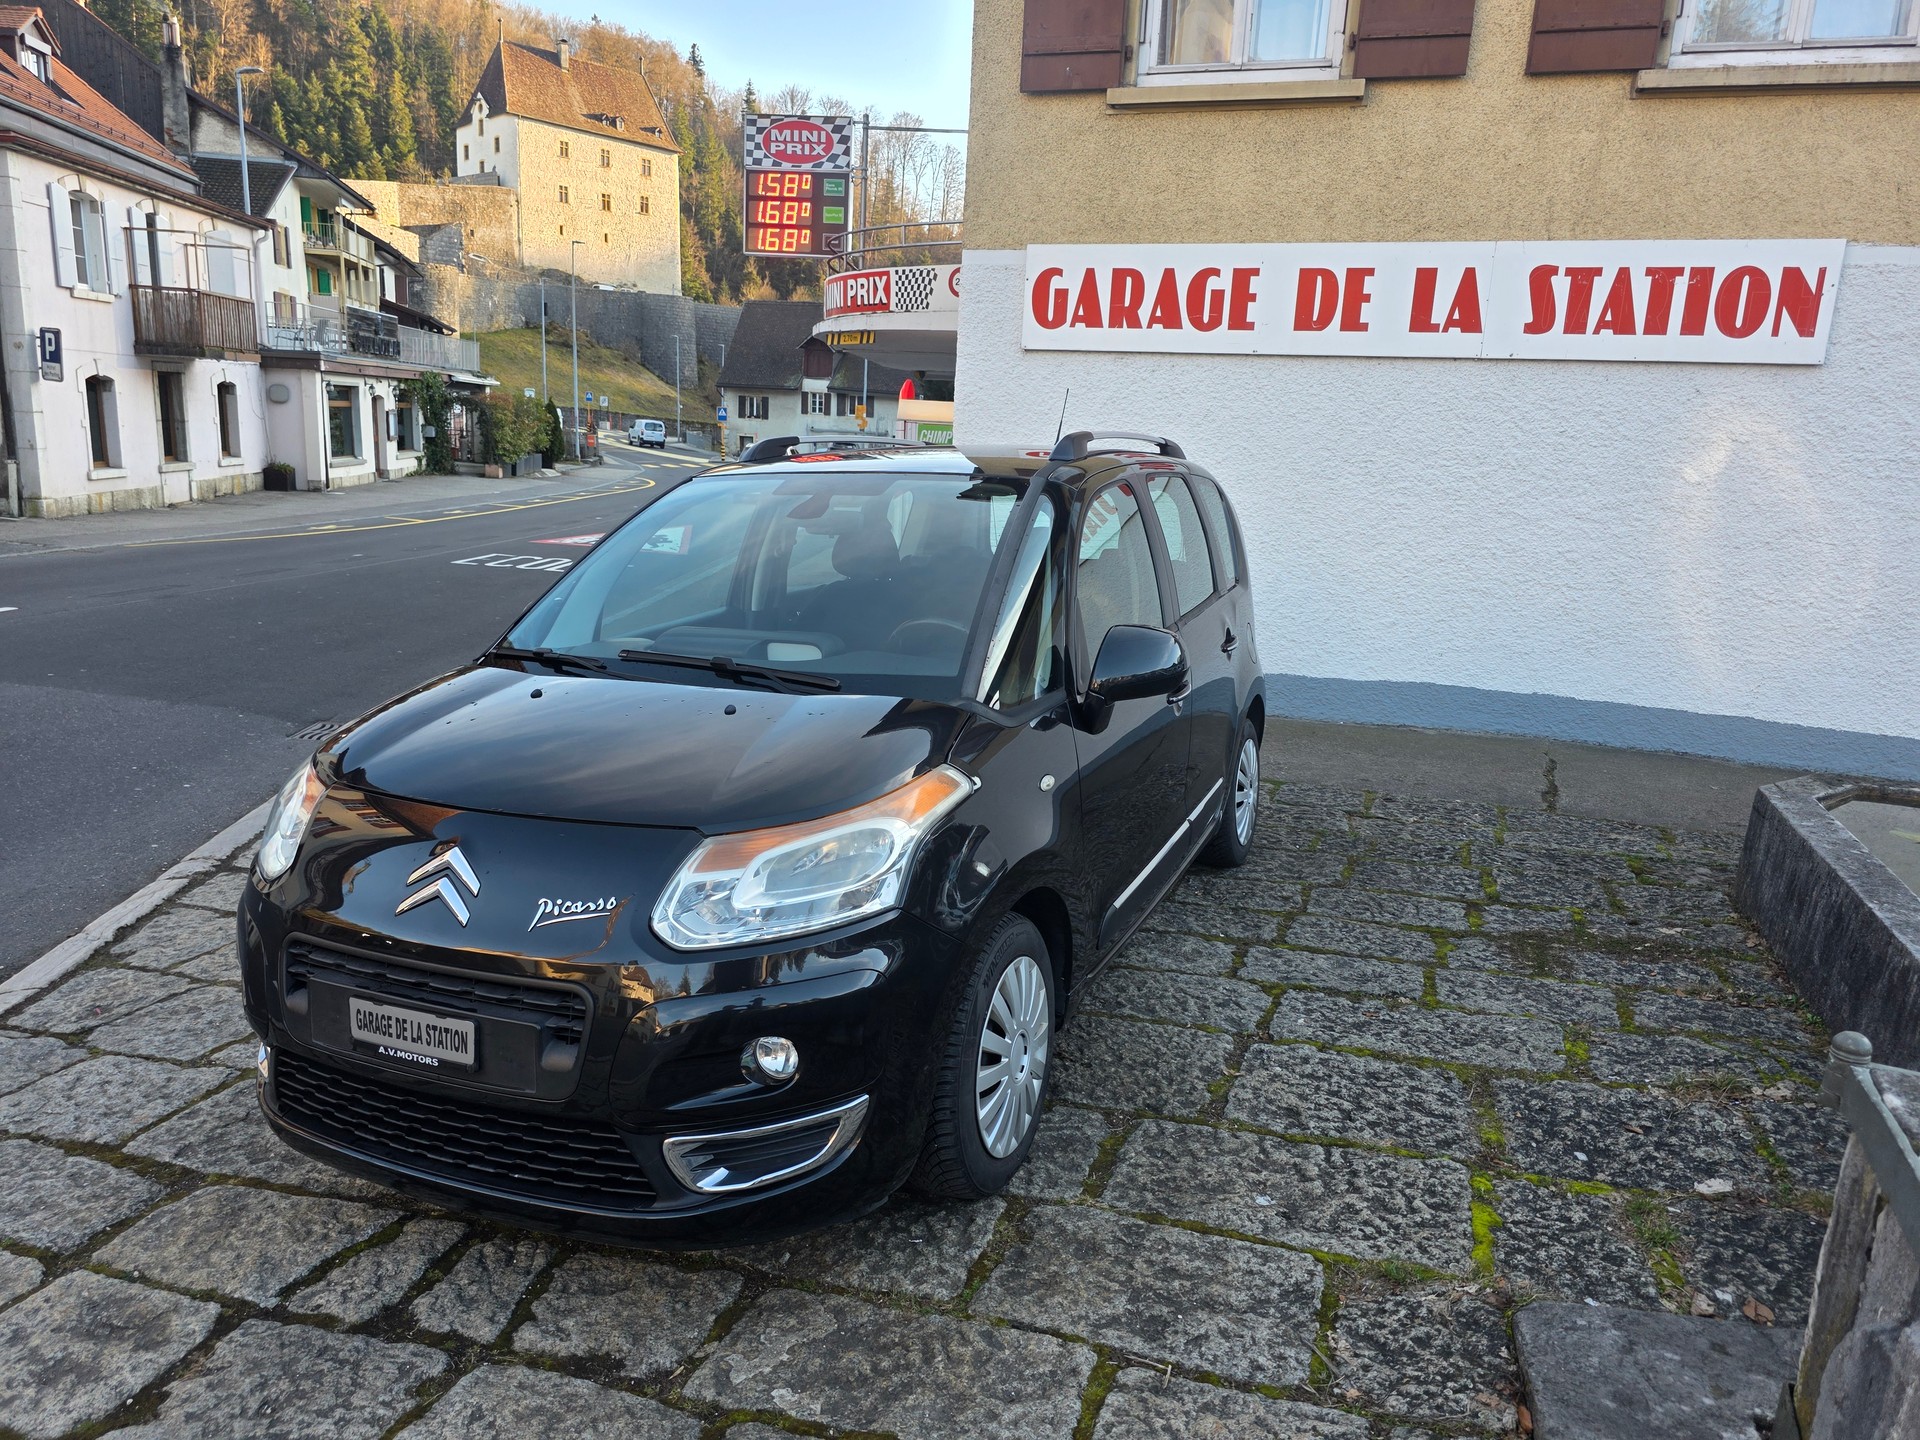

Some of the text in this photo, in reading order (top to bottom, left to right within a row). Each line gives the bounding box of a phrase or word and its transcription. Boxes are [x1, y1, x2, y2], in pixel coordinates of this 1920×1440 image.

[769, 129, 827, 143] MINI
[769, 142, 827, 156] PRIX
[826, 275, 888, 311] MINI PRIX
[1031, 264, 1827, 339] GARAGE DE LA STATION
[44, 332, 56, 360] P
[527, 896, 617, 932] Picasso
[355, 1008, 468, 1054] GARAGE DE LA STATION
[378, 1045, 439, 1067] A.V.MOTORS
